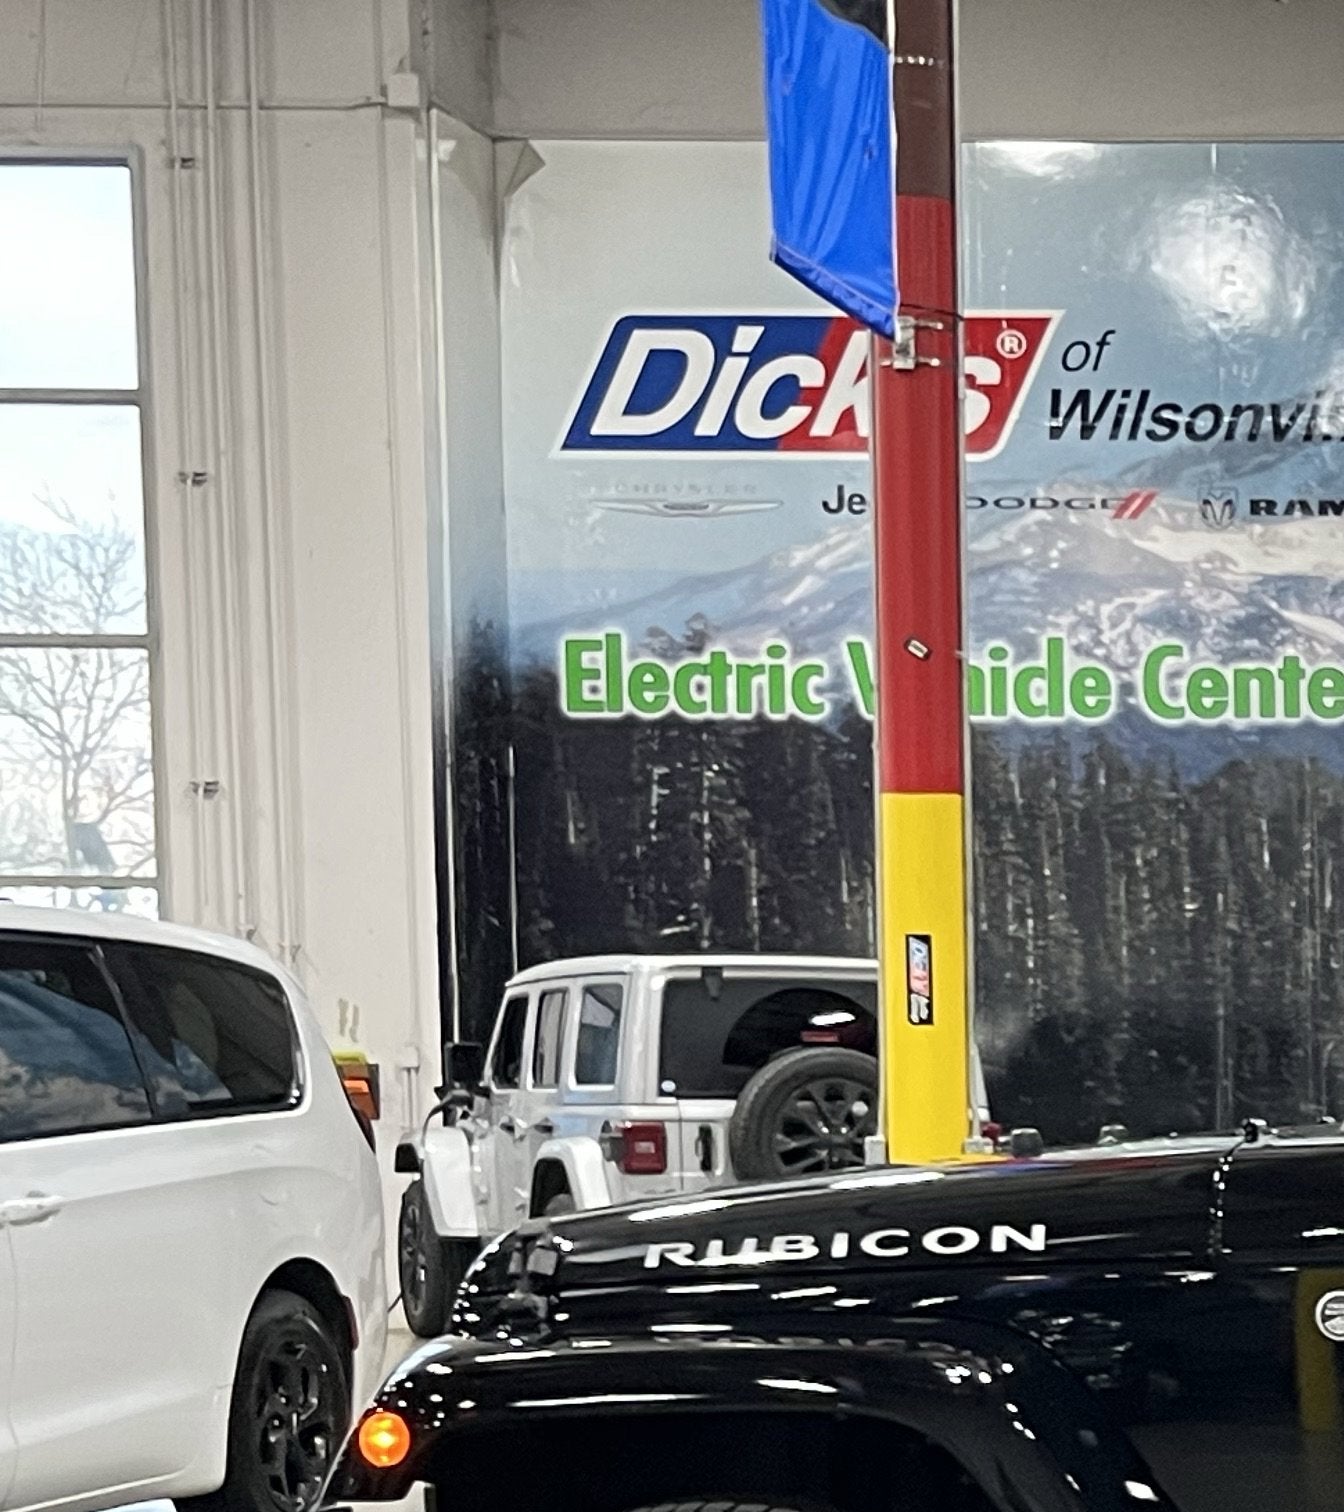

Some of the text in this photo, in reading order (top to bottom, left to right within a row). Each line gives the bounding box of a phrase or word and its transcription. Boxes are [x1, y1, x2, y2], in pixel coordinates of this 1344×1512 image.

[1061, 330, 1117, 372] of
[821, 484, 868, 515] Je
[565, 633, 827, 715] Electric
[643, 1223, 1047, 1268] RUBICON
